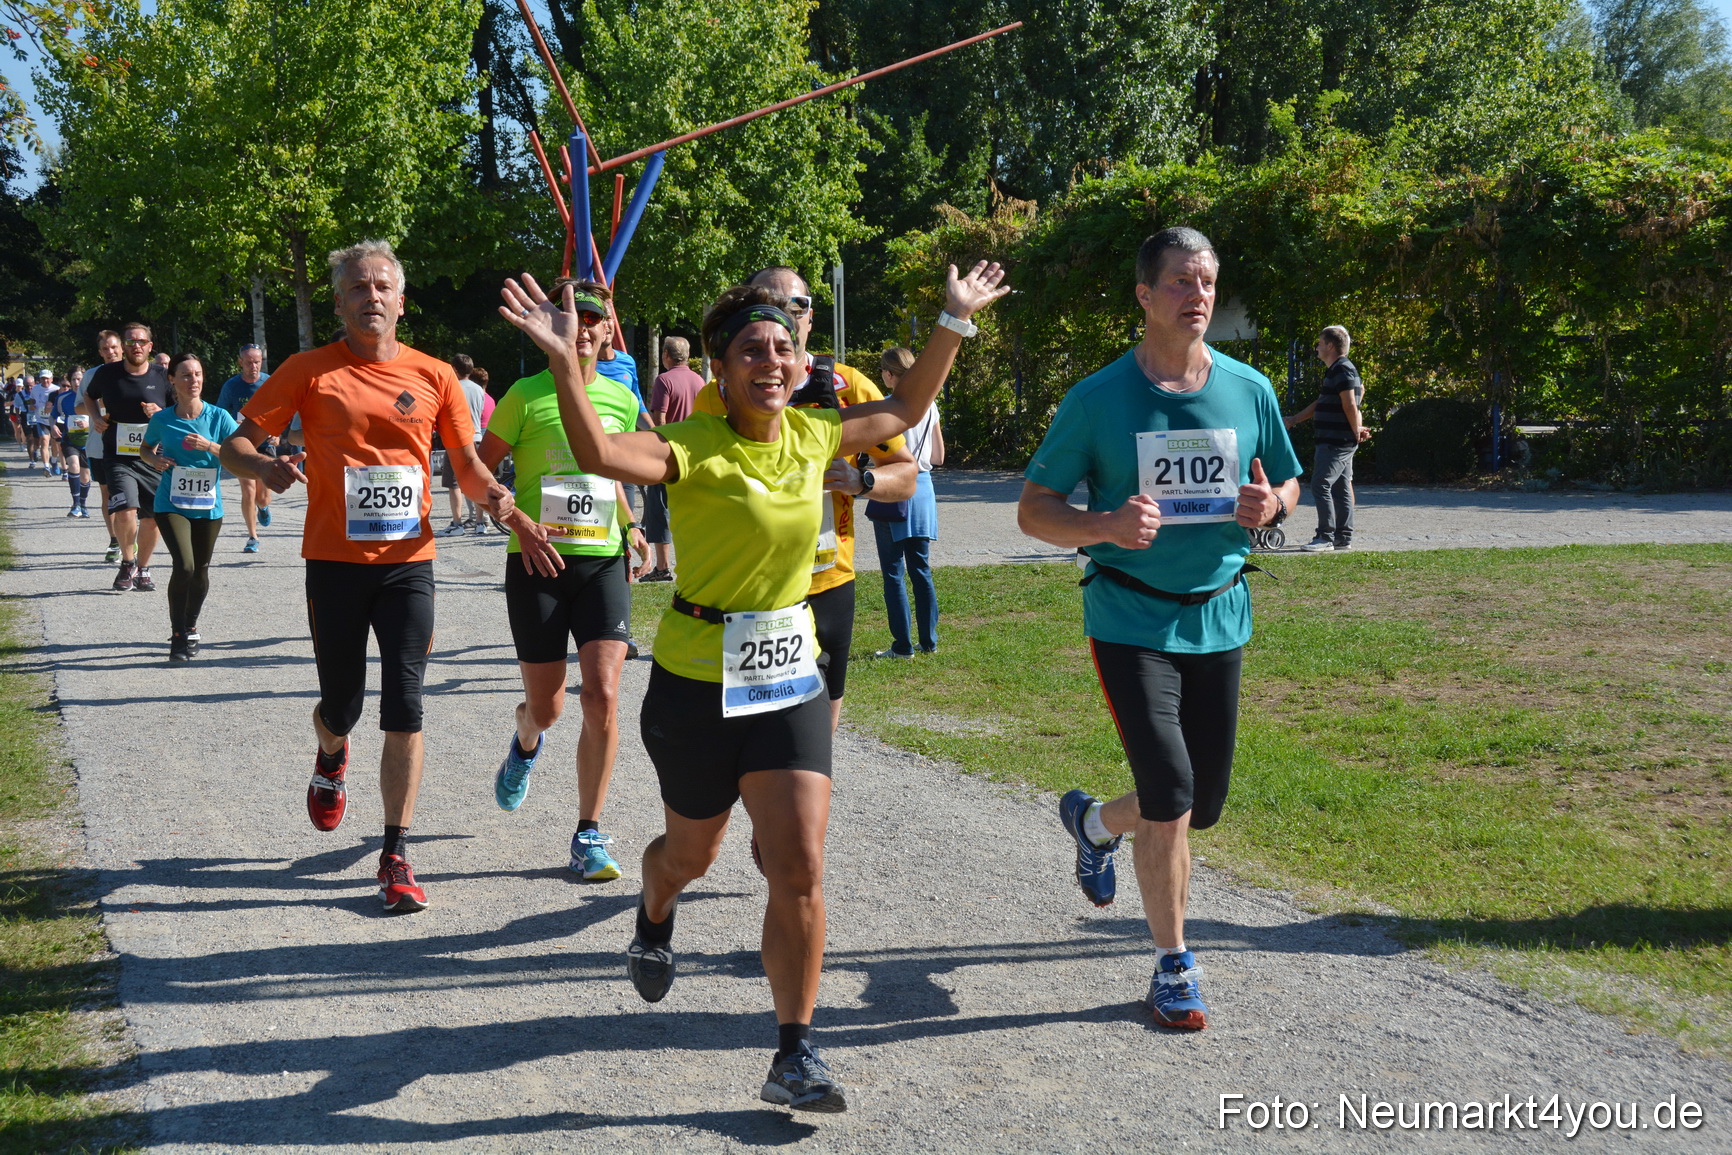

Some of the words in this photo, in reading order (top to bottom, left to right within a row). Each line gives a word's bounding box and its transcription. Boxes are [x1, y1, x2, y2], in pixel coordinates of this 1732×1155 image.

[129, 433, 142, 443] 64
[1167, 438, 1211, 450] BOCK
[369, 472, 402, 480] BOCK
[1154, 456, 1225, 485] 2102
[178, 478, 210, 492] 3115
[358, 486, 413, 509] 2539
[567, 494, 593, 515] 66
[1173, 501, 1210, 513] Volker
[369, 521, 404, 532] Michael
[756, 617, 793, 632] BOCK
[739, 634, 803, 671] 2552
[765, 670, 790, 680] Neumarkt
[748, 683, 795, 702] Cornelia
